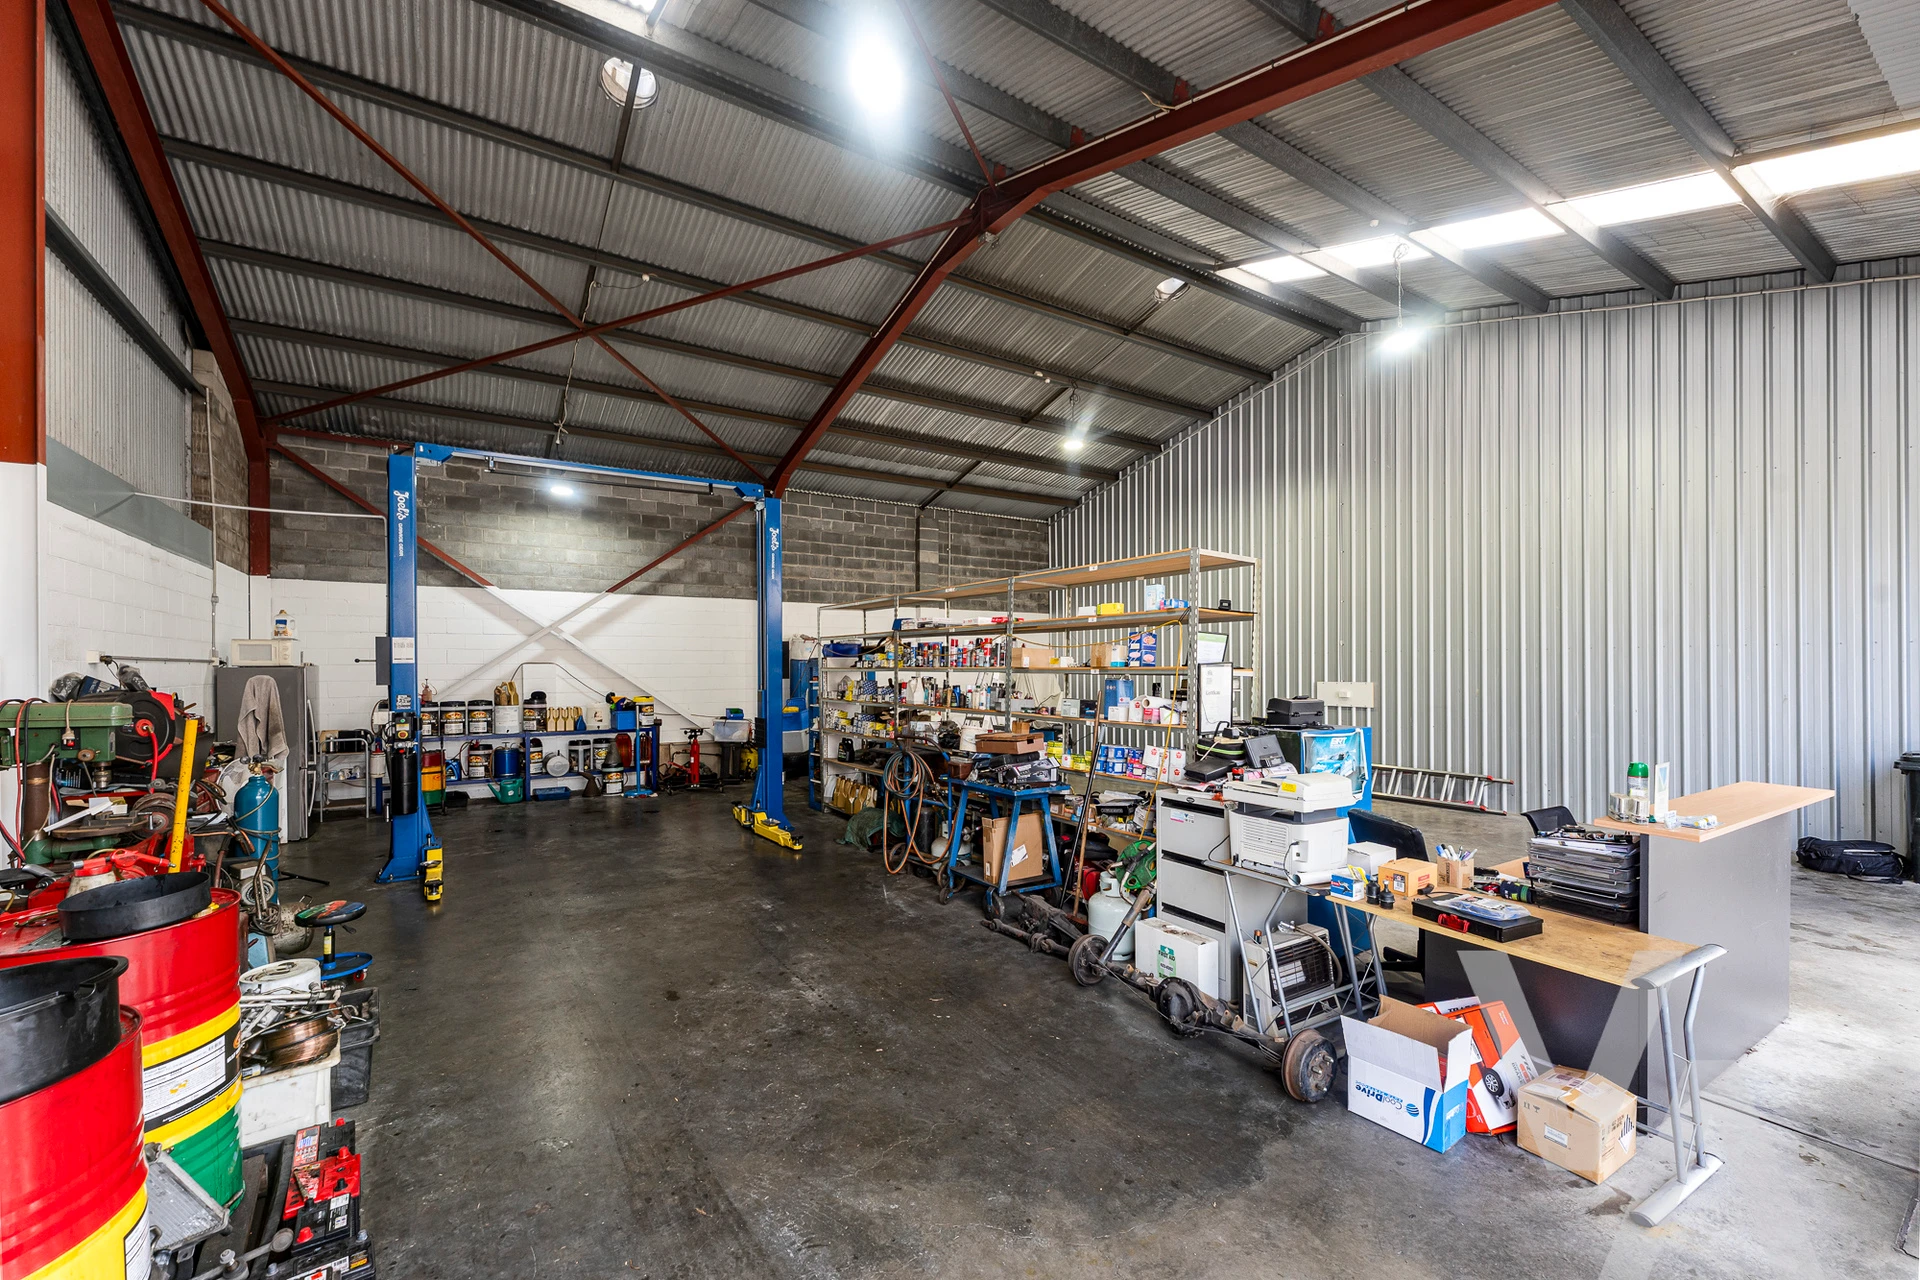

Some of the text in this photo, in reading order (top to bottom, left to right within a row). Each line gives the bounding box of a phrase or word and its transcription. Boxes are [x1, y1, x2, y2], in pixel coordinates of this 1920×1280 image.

[393, 490, 410, 520] Joel's
[769, 527, 780, 552] Joel's
[1355, 1084, 1403, 1110] CoolDrive
